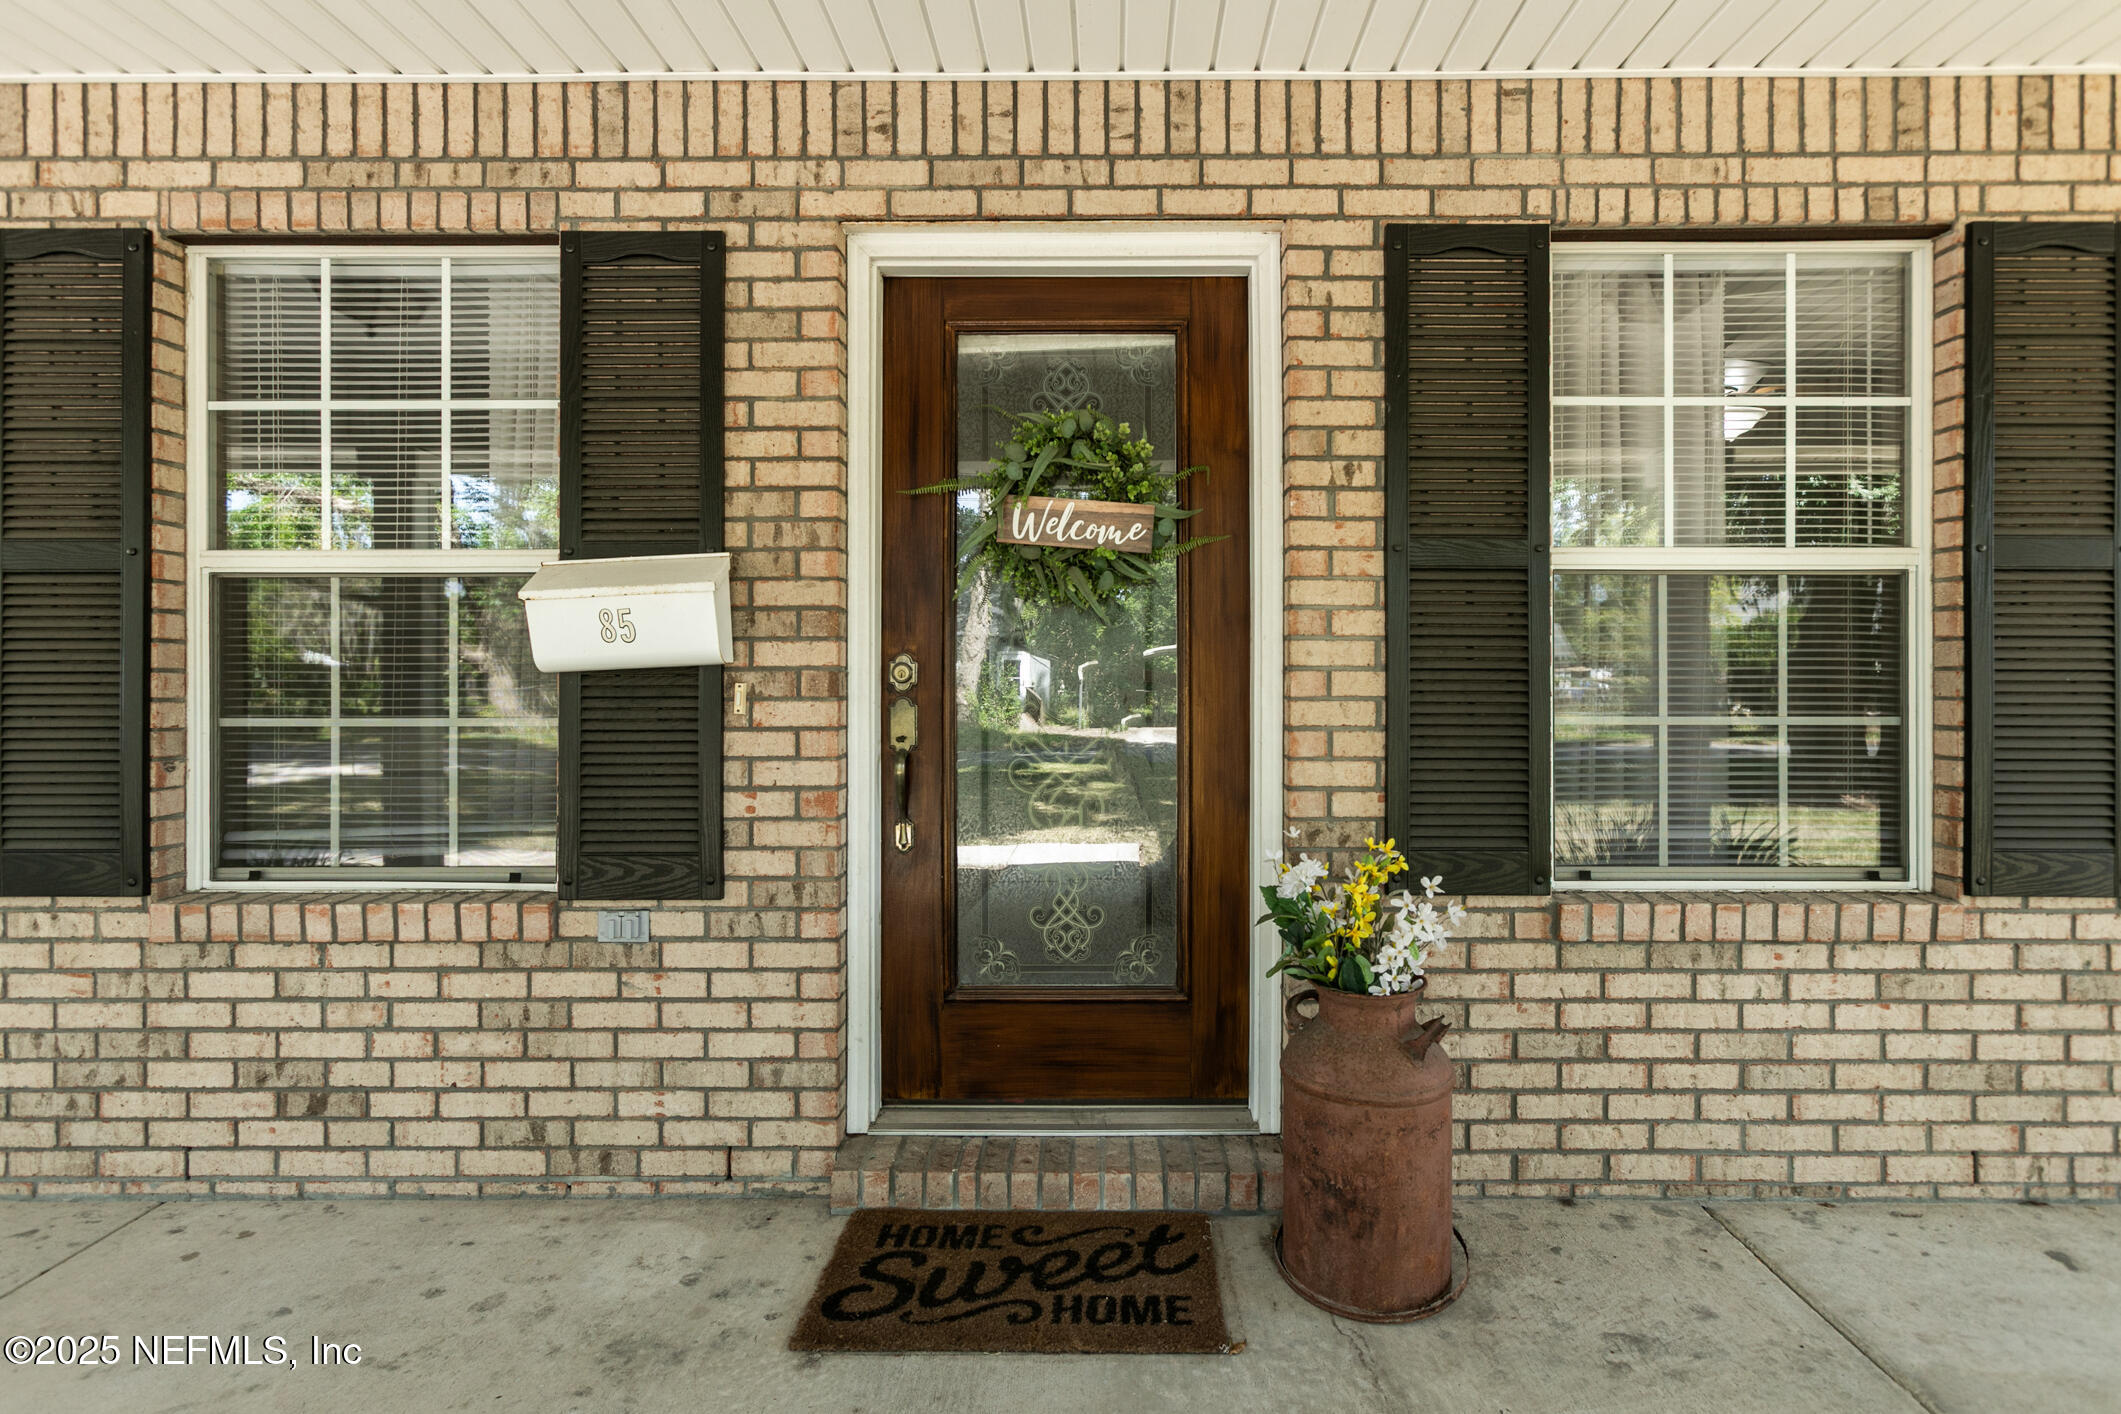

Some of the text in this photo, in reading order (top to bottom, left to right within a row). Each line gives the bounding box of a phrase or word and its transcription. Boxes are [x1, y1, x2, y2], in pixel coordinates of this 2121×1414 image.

[1012, 500, 1147, 545] Welcome
[598, 608, 637, 643] 85
[876, 1224, 1006, 1250] HOME
[821, 1224, 1199, 1322] Sweet
[1049, 1295, 1195, 1326] HOME
